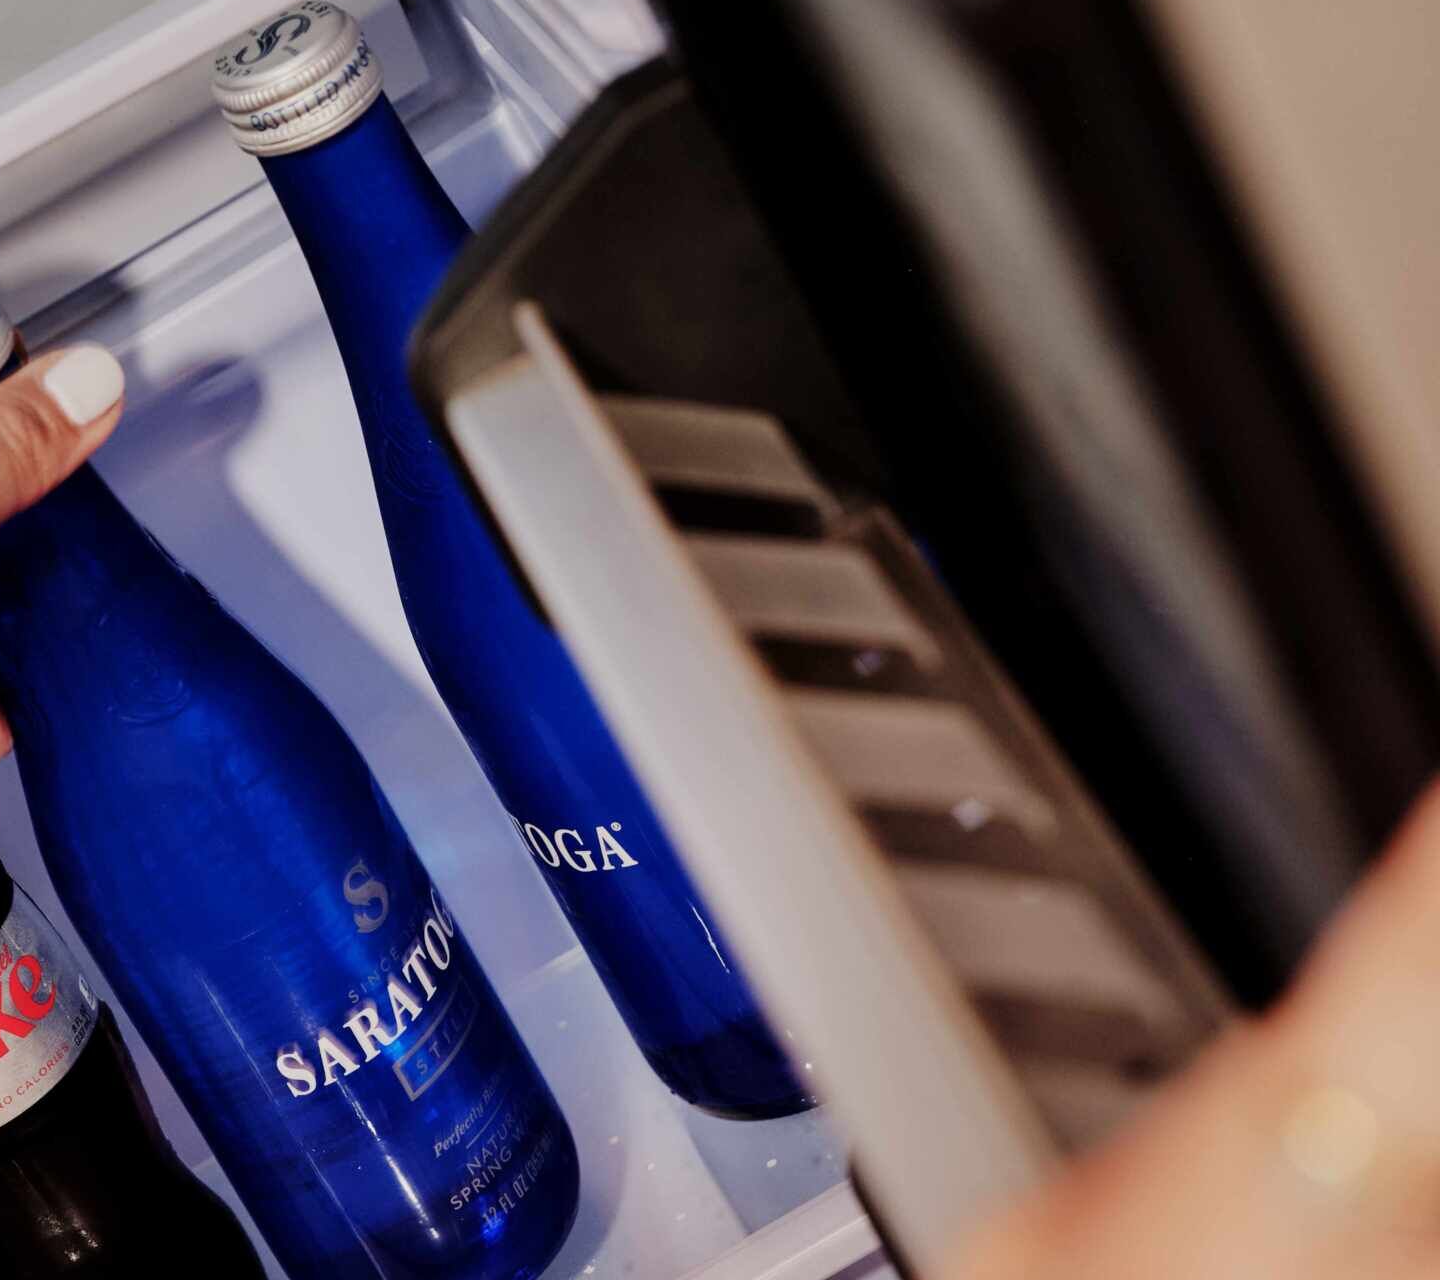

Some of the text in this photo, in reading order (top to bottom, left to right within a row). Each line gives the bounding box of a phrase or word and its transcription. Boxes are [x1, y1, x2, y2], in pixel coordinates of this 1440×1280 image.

[249, 80, 339, 133] BOTTLED
[347, 946, 402, 1005] SINCE
[15, 1041, 71, 1097] CALORIES
[449, 1144, 514, 1211] SPRING
[498, 1192, 517, 1215] FL
[512, 1174, 531, 1199] OZ
